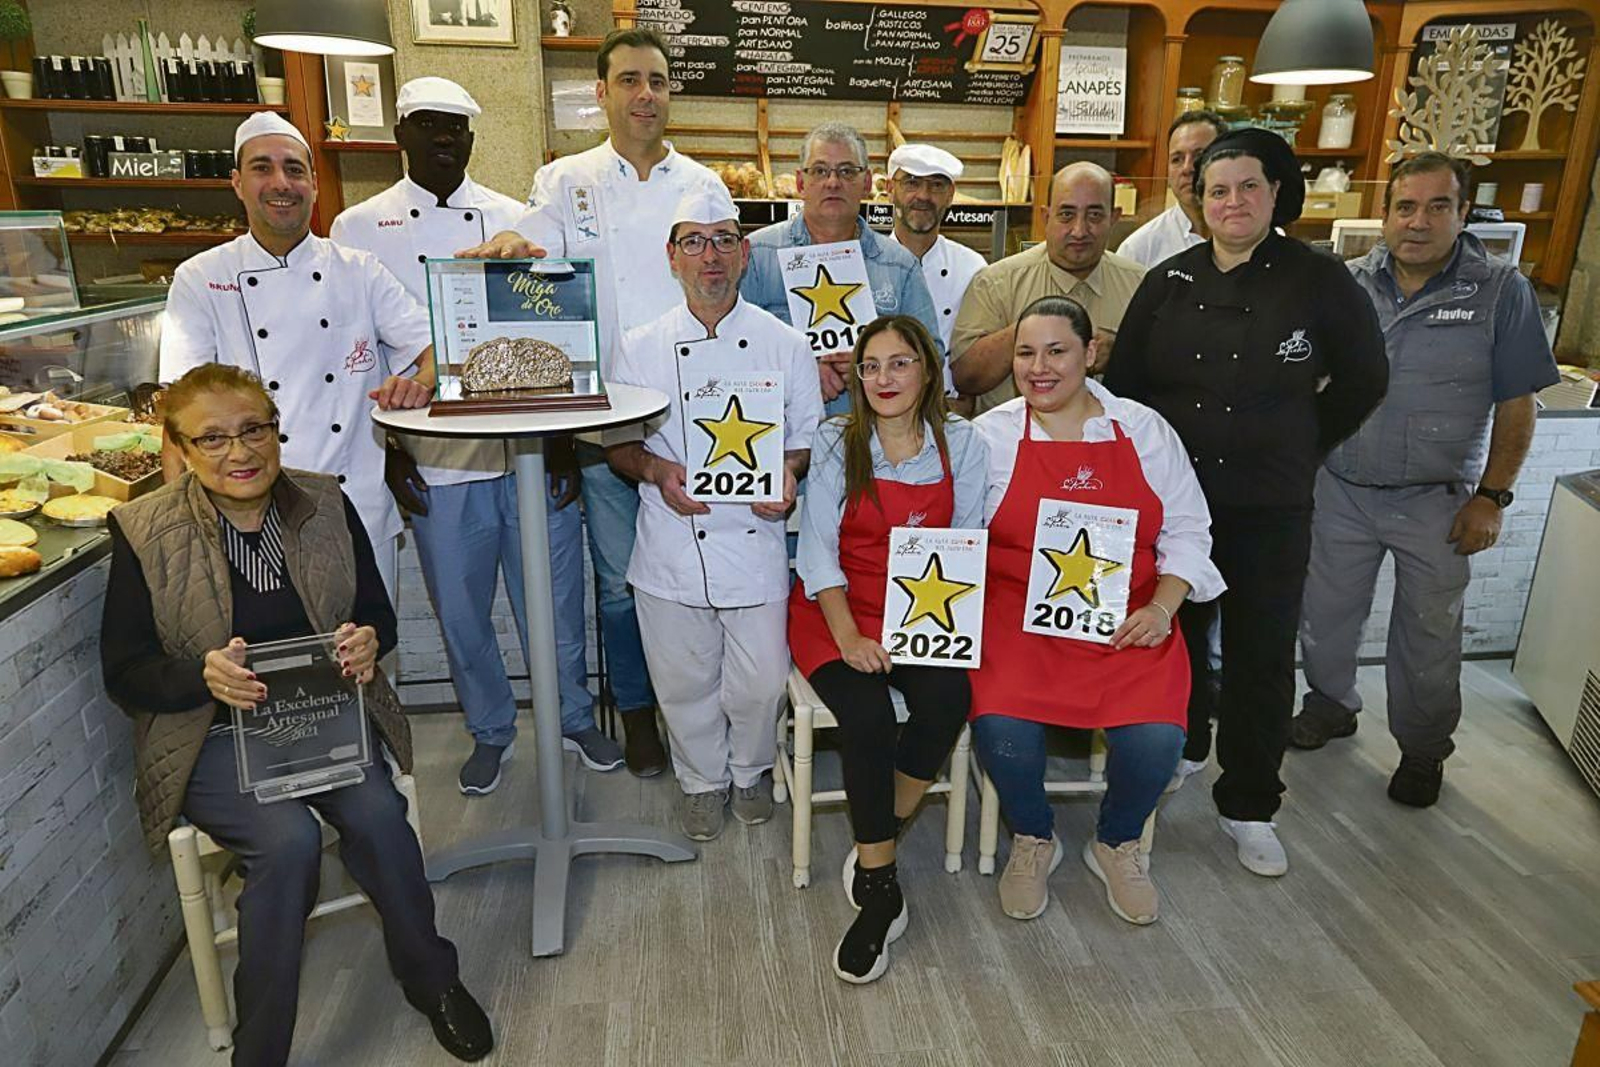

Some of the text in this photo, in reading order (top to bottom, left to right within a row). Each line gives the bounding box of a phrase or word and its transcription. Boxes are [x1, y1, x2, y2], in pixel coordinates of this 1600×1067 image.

[740, 2, 789, 13] CENTENO
[741, 15, 808, 26] pan PINTORA
[879, 10, 927, 20] GALLEGOS
[738, 27, 802, 38] pan NORMAL
[876, 30, 932, 40] PAN NORMAL
[1429, 26, 1509, 40] EMDAS
[739, 39, 793, 49] ARTESANO
[875, 39, 894, 48] PAN
[990, 35, 1021, 55] 25
[670, 61, 686, 69] on
[875, 57, 907, 67] MOLDE
[670, 71, 705, 80] LLEGO
[766, 76, 785, 84] pan
[786, 75, 836, 86] INTEGRAL
[849, 77, 892, 89] Baguette
[904, 79, 953, 89] ARTESANA
[767, 87, 786, 96] pan
[787, 86, 828, 96] NORMAL
[902, 88, 942, 99] NORMAL
[112, 157, 158, 177] Miel
[874, 205, 888, 214] Pan
[868, 214, 893, 225] Negro
[945, 210, 995, 223] Artesano
[507, 271, 559, 303] Miga
[535, 298, 564, 319] Oro
[1436, 308, 1475, 320] Javier
[804, 325, 867, 352] 201
[692, 471, 772, 496] 2021
[1031, 602, 1116, 637] 2018
[888, 632, 974, 661] 2022
[295, 686, 307, 699] A
[252, 690, 350, 718] La Excelencia
[266, 704, 341, 731] Artesanal
